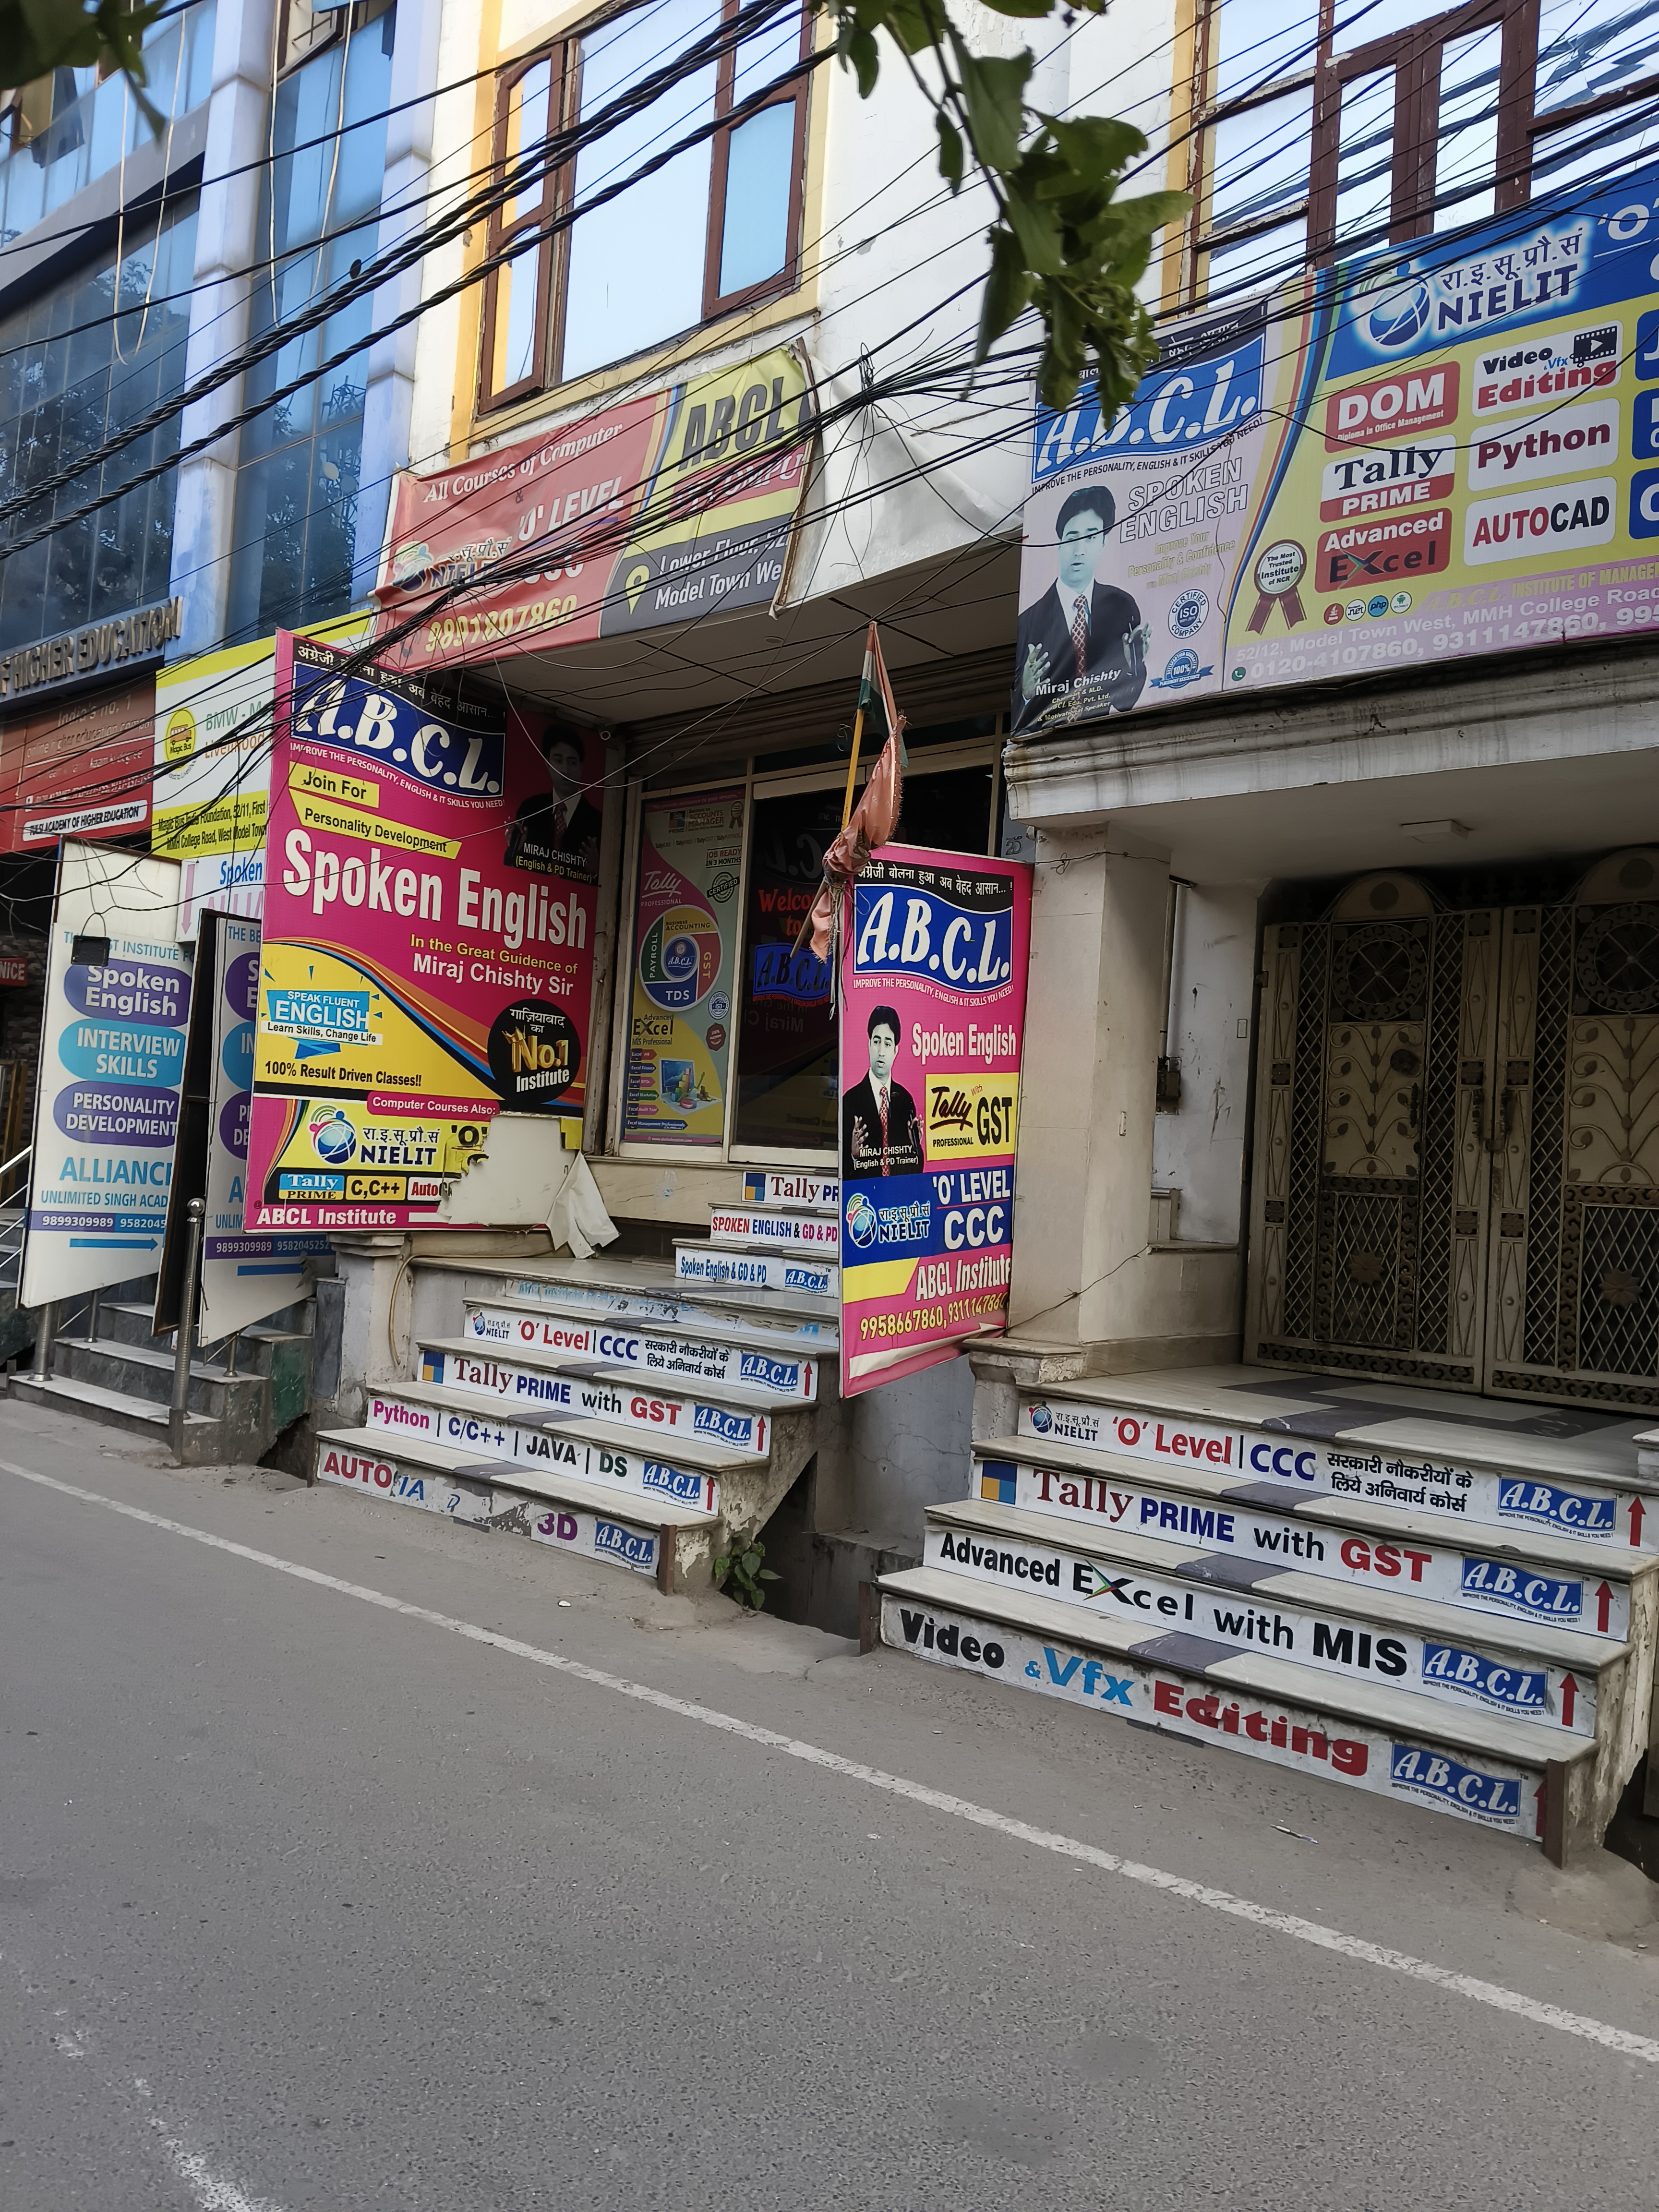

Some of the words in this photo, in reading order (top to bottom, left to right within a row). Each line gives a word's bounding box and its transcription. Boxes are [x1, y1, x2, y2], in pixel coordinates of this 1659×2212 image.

[1437, 263, 1578, 330] NIELIT
[1338, 373, 1445, 430] DOM
[678, 376, 784, 472] ABCL
[1478, 423, 1611, 470] Python
[422, 478, 449, 503] All
[452, 461, 517, 496] Courses
[519, 454, 537, 476] of
[539, 421, 624, 466] Computer
[1129, 457, 1243, 511] SPOKEN
[1342, 481, 1431, 516] PRIME
[1119, 484, 1249, 544] ENGLISH
[1155, 538, 1188, 554] Improve
[1191, 532, 1209, 543] Your
[1324, 511, 1443, 552] Advanced
[1129, 557, 1175, 577] Personality
[1177, 554, 1183, 565] &
[1186, 541, 1235, 562] Confidence
[1269, 559, 1292, 567] Trusted
[1261, 566, 1299, 578] Institute
[655, 578, 704, 610] Model
[708, 570, 749, 596] Town
[1172, 591, 1206, 613] CERTIFIED
[1179, 605, 1198, 617] ISO
[1348, 606, 1364, 617] .net
[1370, 600, 1387, 612] php
[425, 595, 577, 652] 9891807860
[1171, 617, 1203, 637] COMPANY
[1236, 643, 1283, 662] 52/12,
[1290, 630, 1342, 651] Model
[1348, 625, 1397, 646] Town
[1404, 613, 1455, 634] West,
[1464, 606, 1513, 625] MMH
[1520, 595, 1599, 617] College
[1173, 663, 1190, 675] 100%
[1036, 680, 1069, 695] Miraj
[1074, 670, 1121, 687] Chishty
[1045, 708, 1083, 720] Motivational
[1084, 701, 1111, 711] Speaker
[301, 771, 336, 793] Join
[341, 780, 367, 800] For
[72, 817, 80, 827] OF
[81, 812, 103, 826] HIGHER
[105, 805, 139, 821] EDUCATION
[688, 817, 724, 828] MANAGER
[689, 810, 723, 819] ACCOUNTS
[305, 807, 372, 837] Personality
[375, 824, 446, 853] Development
[707, 850, 718, 859] JOB
[720, 847, 742, 856] READY
[219, 857, 263, 890] Spoken
[644, 871, 682, 894] Tally
[889, 864, 914, 880] बोलना
[918, 869, 935, 885] हुआ
[939, 877, 952, 891] अब
[956, 875, 971, 896] बेहद
[283, 829, 442, 921] Spoken
[457, 867, 586, 950] English
[709, 878, 738, 896] CERTIFIED
[641, 898, 682, 906] PROFESSIONAL
[228, 926, 246, 941] THE
[665, 922, 710, 931] ACCOUNTING
[857, 892, 1010, 984] A.B.C.L.
[123, 941, 179, 961] INSTITUTE
[410, 934, 423, 947] In
[429, 938, 452, 952] the
[456, 941, 495, 960] Great
[499, 949, 561, 972] Guidence
[565, 963, 577, 974] of
[649, 932, 658, 978] PAYROLL
[413, 952, 464, 984] Miraj
[468, 962, 542, 995] Chishty
[548, 976, 573, 996] Sir
[703, 952, 711, 979] GST
[87, 965, 179, 994] Spoken
[85, 986, 177, 1016] English
[288, 991, 321, 1004] SPEAK
[323, 995, 360, 1008] FLUENT
[666, 990, 689, 1000] TDS
[275, 999, 370, 1030] ENGLISH
[77, 1027, 181, 1057] INTERVIEW
[913, 1022, 963, 1065] Spoken
[968, 1023, 1016, 1065] English
[96, 1054, 157, 1080] SKILLS
[264, 1060, 297, 1077] 100%
[300, 1063, 336, 1080] Result
[338, 1067, 372, 1082] Driven
[375, 1070, 422, 1087] Classes!!
[516, 1068, 569, 1093] Institute
[73, 1092, 175, 1115] PERSONALITY
[66, 1113, 177, 1136] DEVELOPMENT
[860, 1148, 881, 1157] MIRAJ
[883, 1145, 912, 1155] CHISHTY
[933, 1136, 974, 1147] PROFESSIONAL
[361, 1144, 436, 1166] NIELIT
[854, 1159, 878, 1170] (English
[886, 1157, 895, 1166] PD
[896, 1155, 919, 1166] Trainer)
[287, 1175, 338, 1190] Tally
[288, 1190, 337, 1199] PRIME
[771, 1177, 819, 1203] Tally
[41, 1190, 100, 1205] UNLIMITED
[105, 1193, 136, 1206] SINGH
[42, 1215, 113, 1227] 9899309989
[256, 1208, 311, 1225] ABCL
[318, 1208, 396, 1226] Institute
[713, 1216, 749, 1233] SPOKEN
[753, 1220, 791, 1238] ENGLISH
[793, 1223, 800, 1238] &
[802, 1224, 814, 1239] GD
[817, 1225, 823, 1240] &
[826, 1226, 837, 1242] PD
[944, 1205, 1004, 1250] CCC
[879, 1220, 929, 1243] NIELIT
[216, 1242, 272, 1252] 9899309989
[277, 1240, 329, 1250] 9582045252
[786, 1270, 828, 1289] A.B.C.L.
[916, 1262, 952, 1301] ABCL
[956, 1254, 1010, 1292] Institute
[486, 1328, 509, 1339] NIELIT
[645, 1339, 677, 1354] सरकारी
[679, 1342, 718, 1361] नौकरीयों
[719, 1349, 730, 1362] के
[454, 1357, 513, 1393] Tally
[517, 1376, 571, 1404] PRIME
[582, 1391, 622, 1414] with
[631, 1397, 682, 1425] GST
[373, 1400, 429, 1430] Python
[448, 1417, 505, 1446] C/C++
[527, 1436, 577, 1466] JAVA
[600, 1454, 627, 1477] DS
[1055, 1424, 1098, 1441] NIELIT
[1155, 1424, 1232, 1464] Level
[1250, 1444, 1316, 1481] CCC
[1033, 1469, 1133, 1523] Tally
[1141, 1497, 1235, 1543] PRIME
[1254, 1527, 1324, 1561] with
[1340, 1539, 1431, 1583] GST
[940, 1533, 1060, 1587] Advanced
[1214, 1609, 1294, 1650] with
[1313, 1622, 1407, 1677] MIS
[900, 1608, 1005, 1670] Video
[1024, 1660, 1041, 1680] &
[1043, 1647, 1135, 1707] Vfx
[1154, 1680, 1368, 1777] Editing
